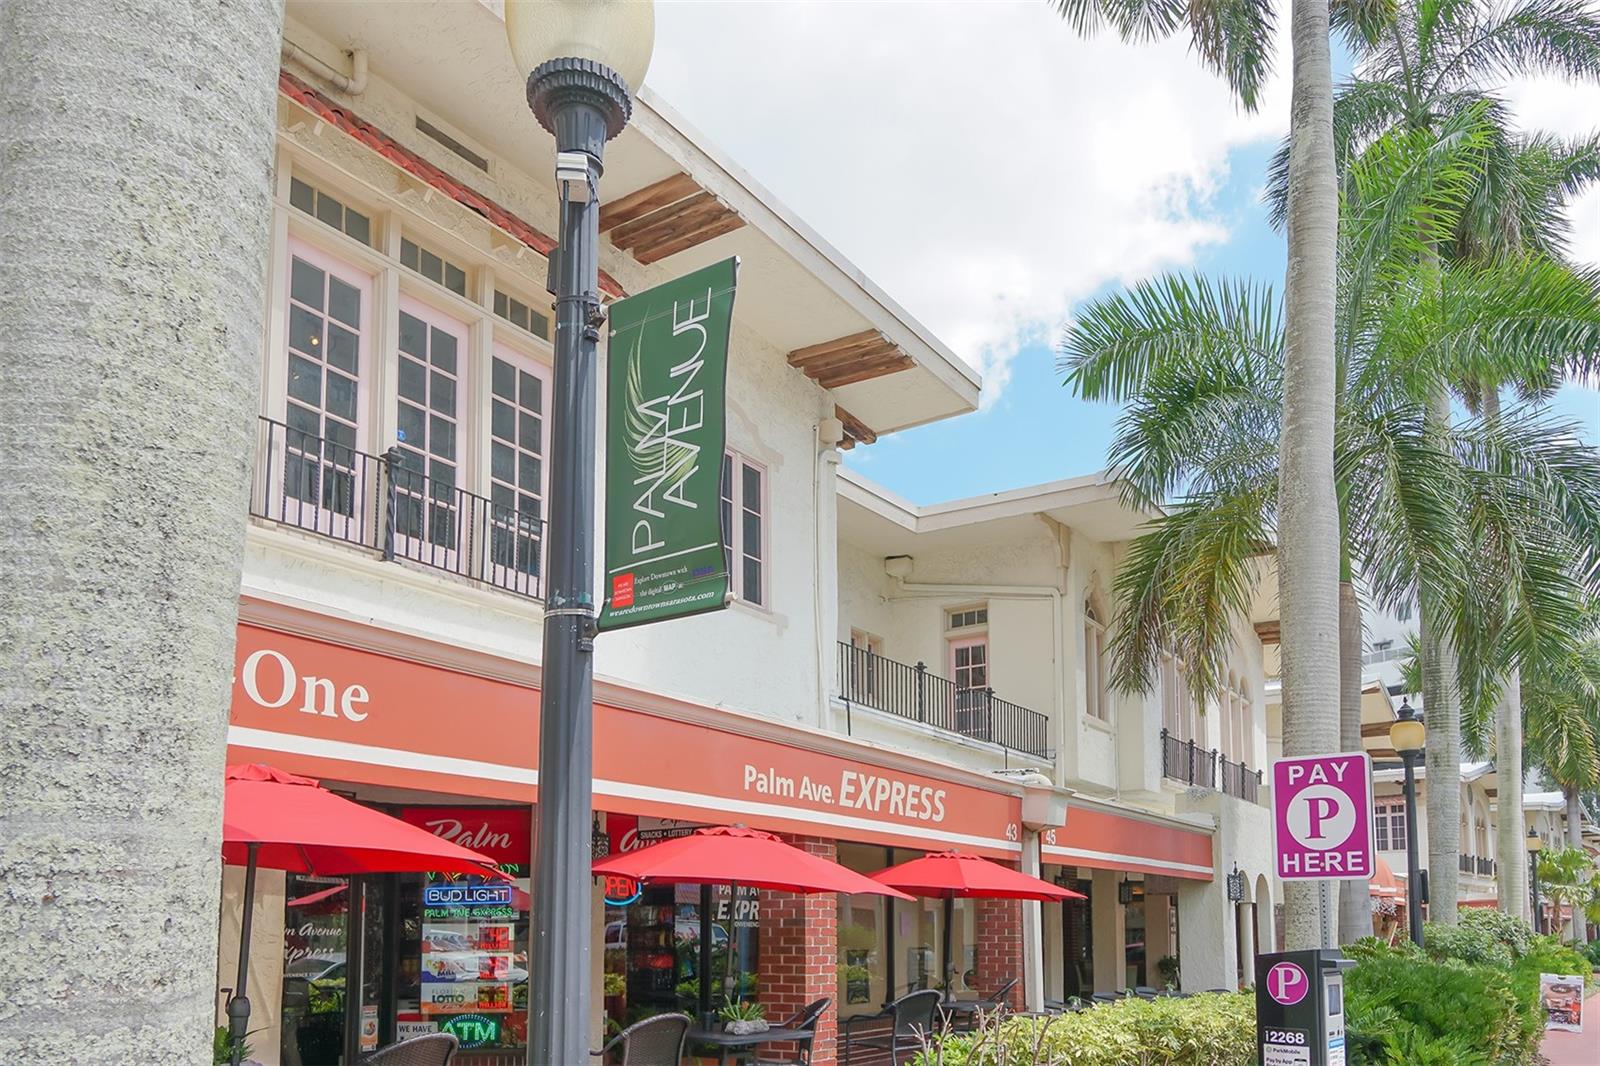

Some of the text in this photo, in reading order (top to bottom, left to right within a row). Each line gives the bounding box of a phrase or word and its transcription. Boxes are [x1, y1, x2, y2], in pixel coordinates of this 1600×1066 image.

[663, 287, 712, 508] AVENUE
[631, 395, 671, 555] PALM
[663, 582, 677, 592] MAP
[232, 649, 370, 722] One
[1288, 761, 1349, 785] PAY
[744, 764, 947, 822] Palm Ave. EXPRESS
[1303, 797, 1340, 839] P
[425, 819, 513, 849] Palm
[640, 829, 693, 840] SNACKS LOTTERY
[1005, 823, 1018, 841] 43
[1046, 828, 1056, 845] 45
[1283, 851, 1364, 873] HERE
[428, 889, 509, 902] BUD LIGHT
[719, 884, 747, 896] PAM
[424, 908, 449, 918] PALM
[474, 907, 513, 918] EXPRESS
[299, 922, 343, 937] Avenue
[1274, 967, 1301, 1000] P
[431, 994, 465, 1004] LOTTO
[398, 1025, 433, 1034] WE HAVE
[442, 1021, 496, 1041] ATM
[1270, 1031, 1304, 1044] 2268
[1272, 1047, 1301, 1055] ParkMobile
